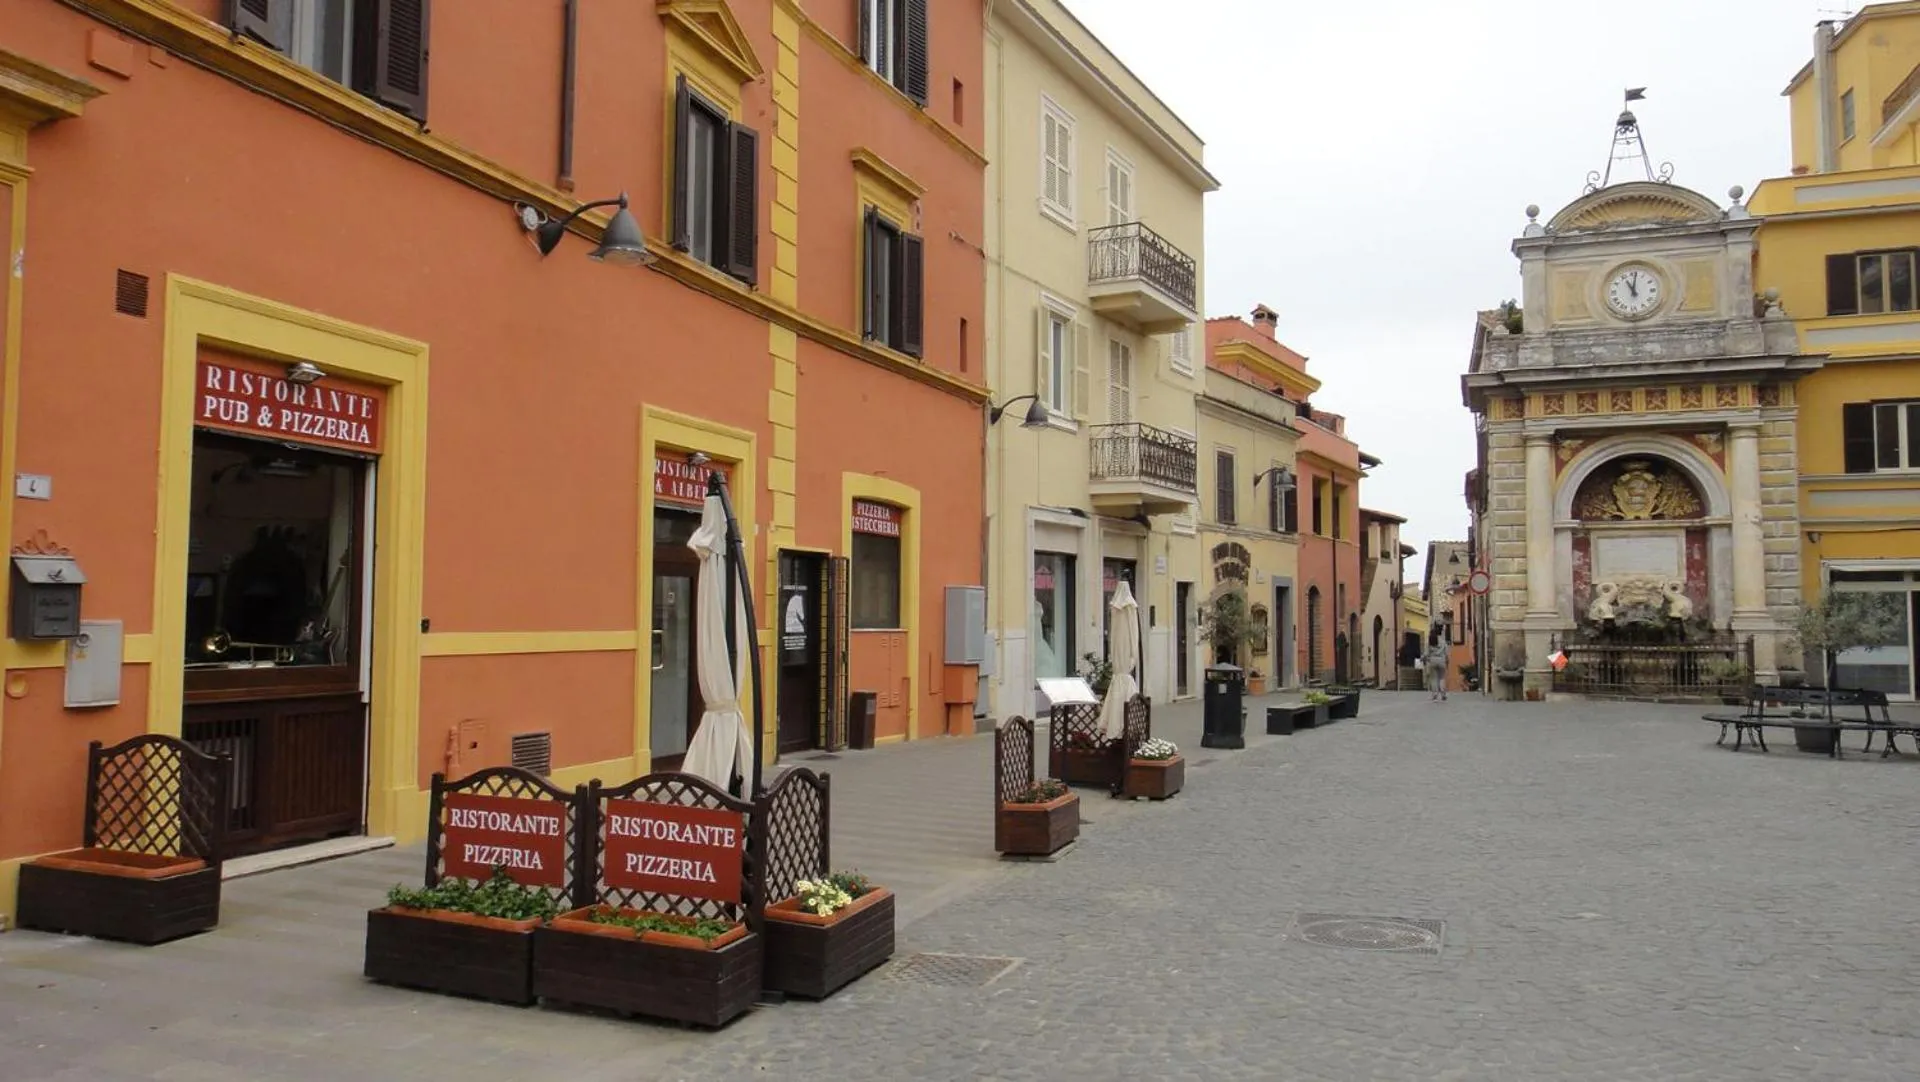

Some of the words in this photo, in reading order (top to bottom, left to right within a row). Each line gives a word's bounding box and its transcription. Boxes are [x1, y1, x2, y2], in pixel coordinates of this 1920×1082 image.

[207, 366, 372, 418] RISTORANTE
[204, 395, 249, 422] PUB
[258, 406, 272, 427] &
[280, 409, 370, 443] PIZZERIA
[856, 502, 890, 520] PIZZERIA
[450, 809, 559, 836] RISTORANTE
[610, 815, 735, 847] RISTORANTE
[463, 843, 544, 871] PIZZERIA
[625, 853, 717, 884] PIZZERIA
